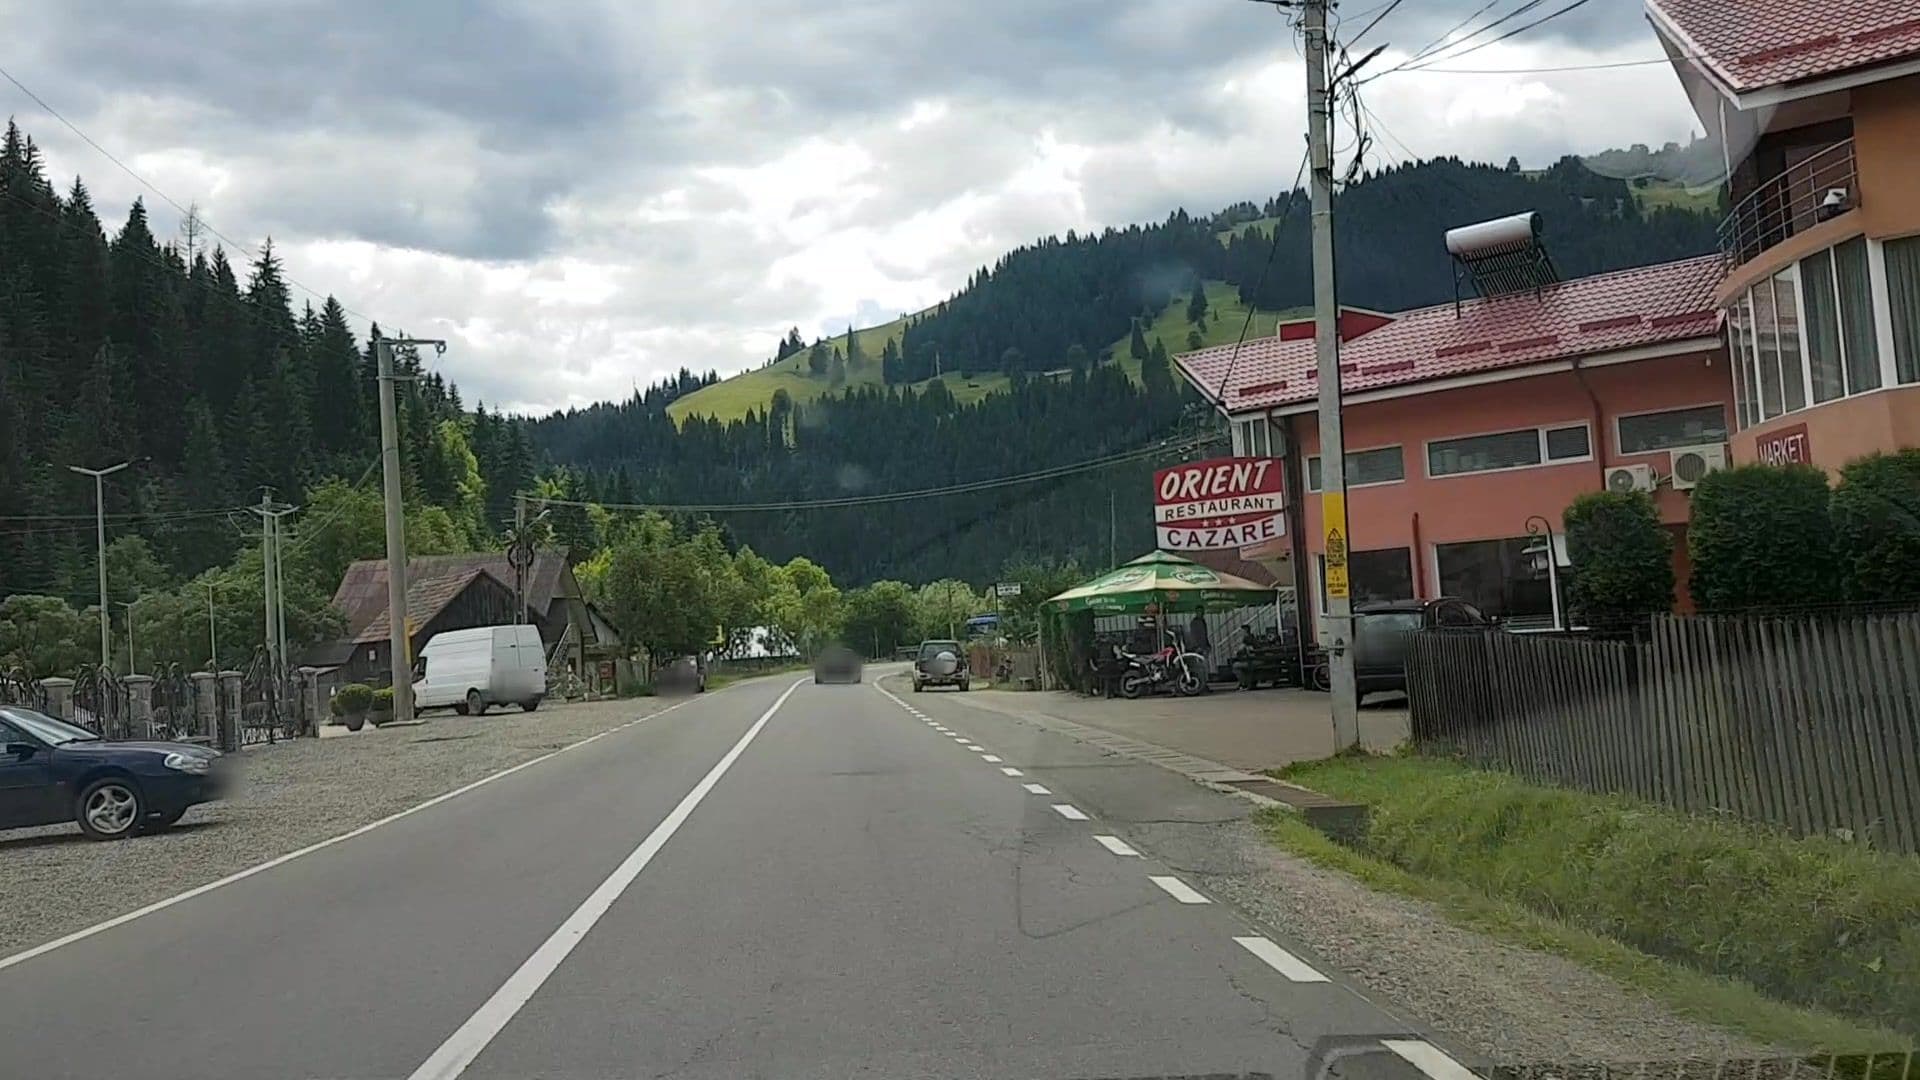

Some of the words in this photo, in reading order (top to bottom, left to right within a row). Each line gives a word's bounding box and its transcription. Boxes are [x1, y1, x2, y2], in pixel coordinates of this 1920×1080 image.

[1160, 460, 1272, 501] ORIENT
[1165, 497, 1275, 521] RESTAURANT
[1167, 517, 1275, 548] CAZARE
